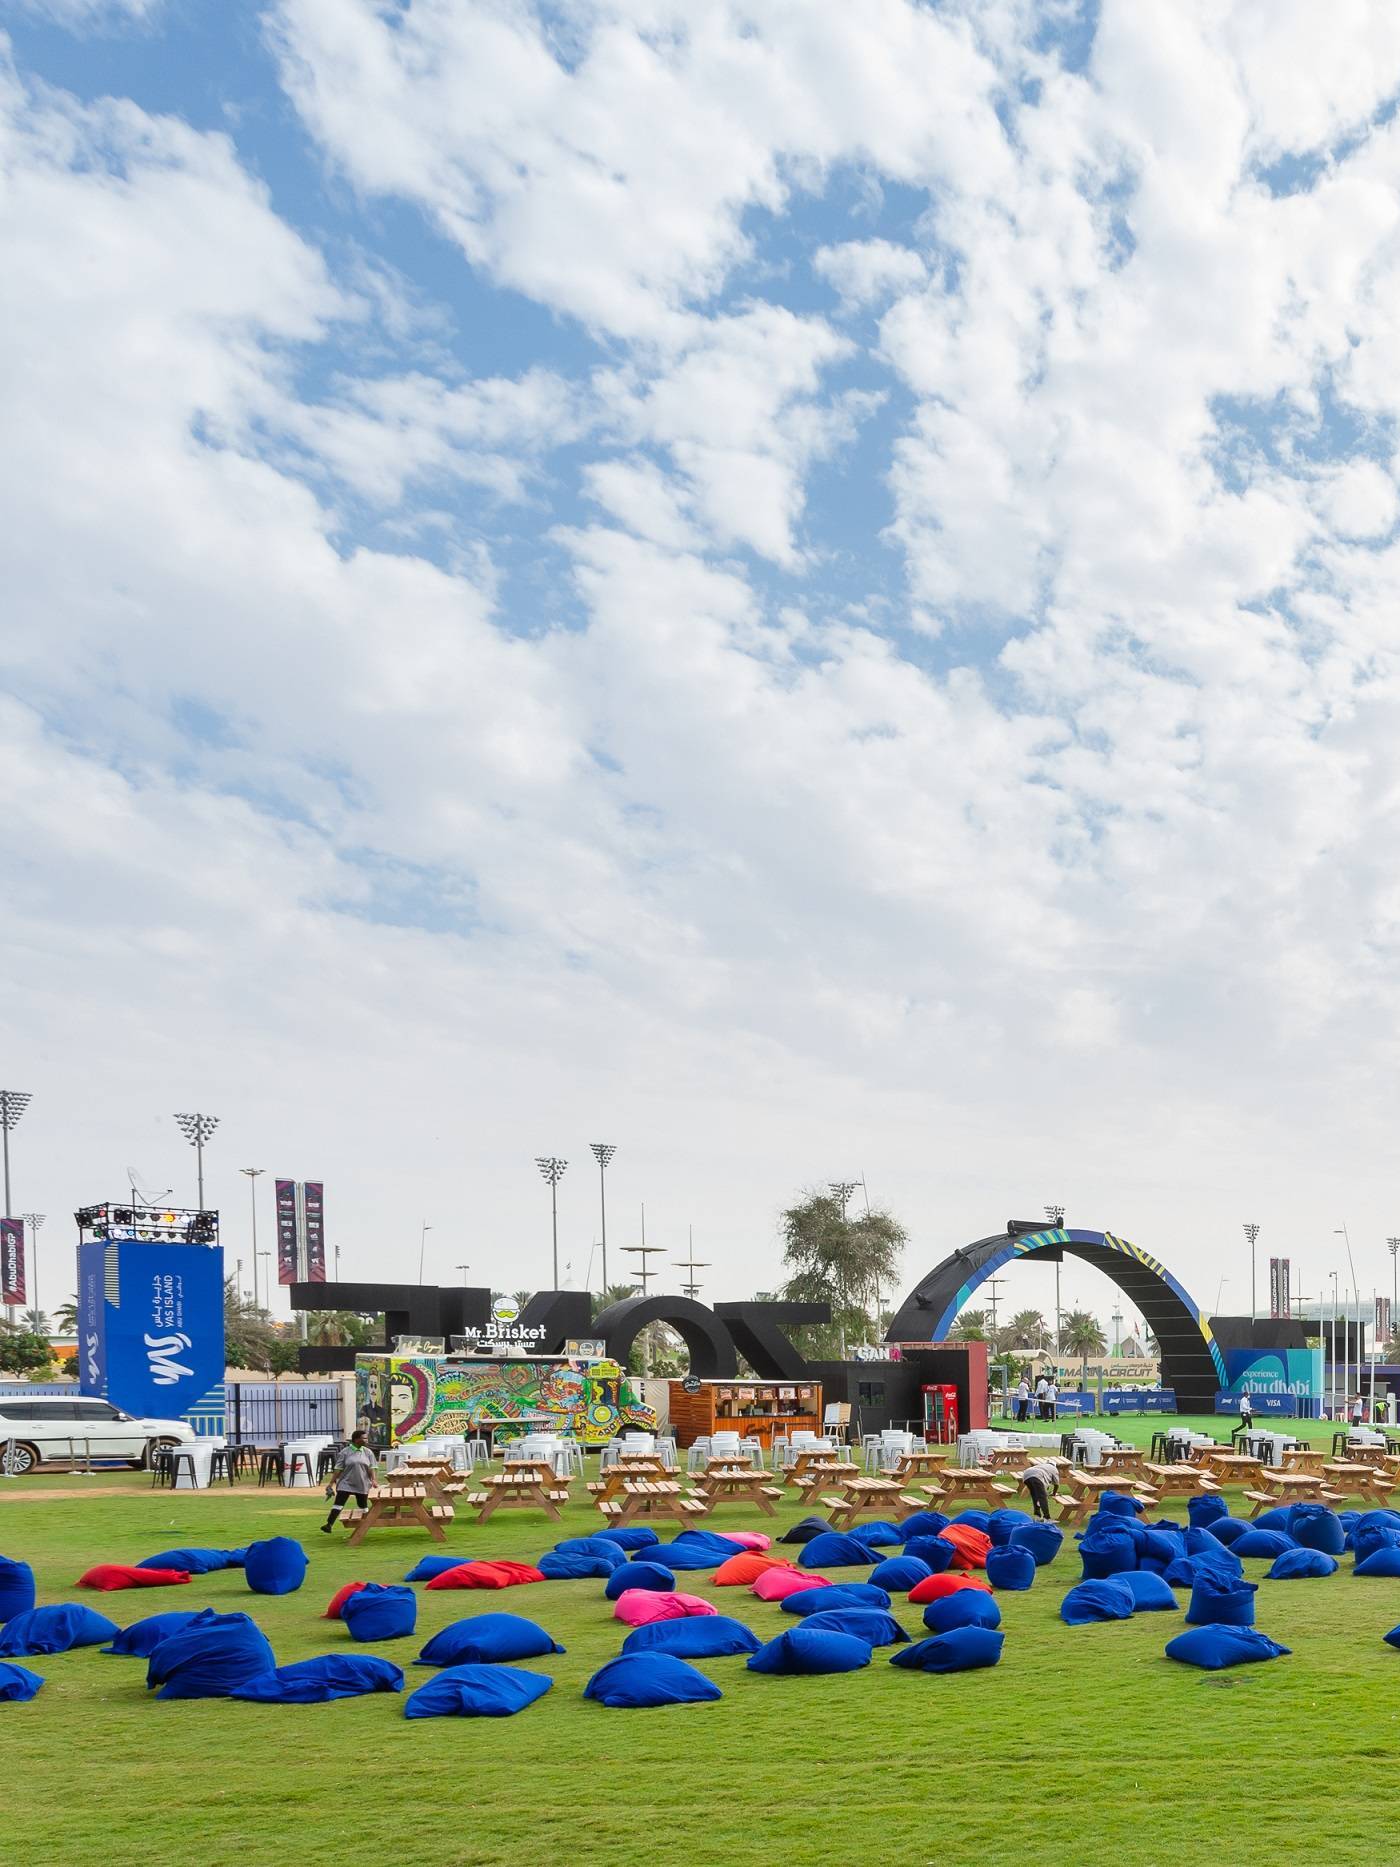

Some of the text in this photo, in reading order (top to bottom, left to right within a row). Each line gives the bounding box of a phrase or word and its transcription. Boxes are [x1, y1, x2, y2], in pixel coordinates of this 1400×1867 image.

[163, 1275, 174, 1328] YAS ISLAND
[464, 1323, 547, 1340] Mr. Brisket
[1109, 1368, 1153, 1377] CIRCUIT
[1242, 1370, 1279, 1378] experience
